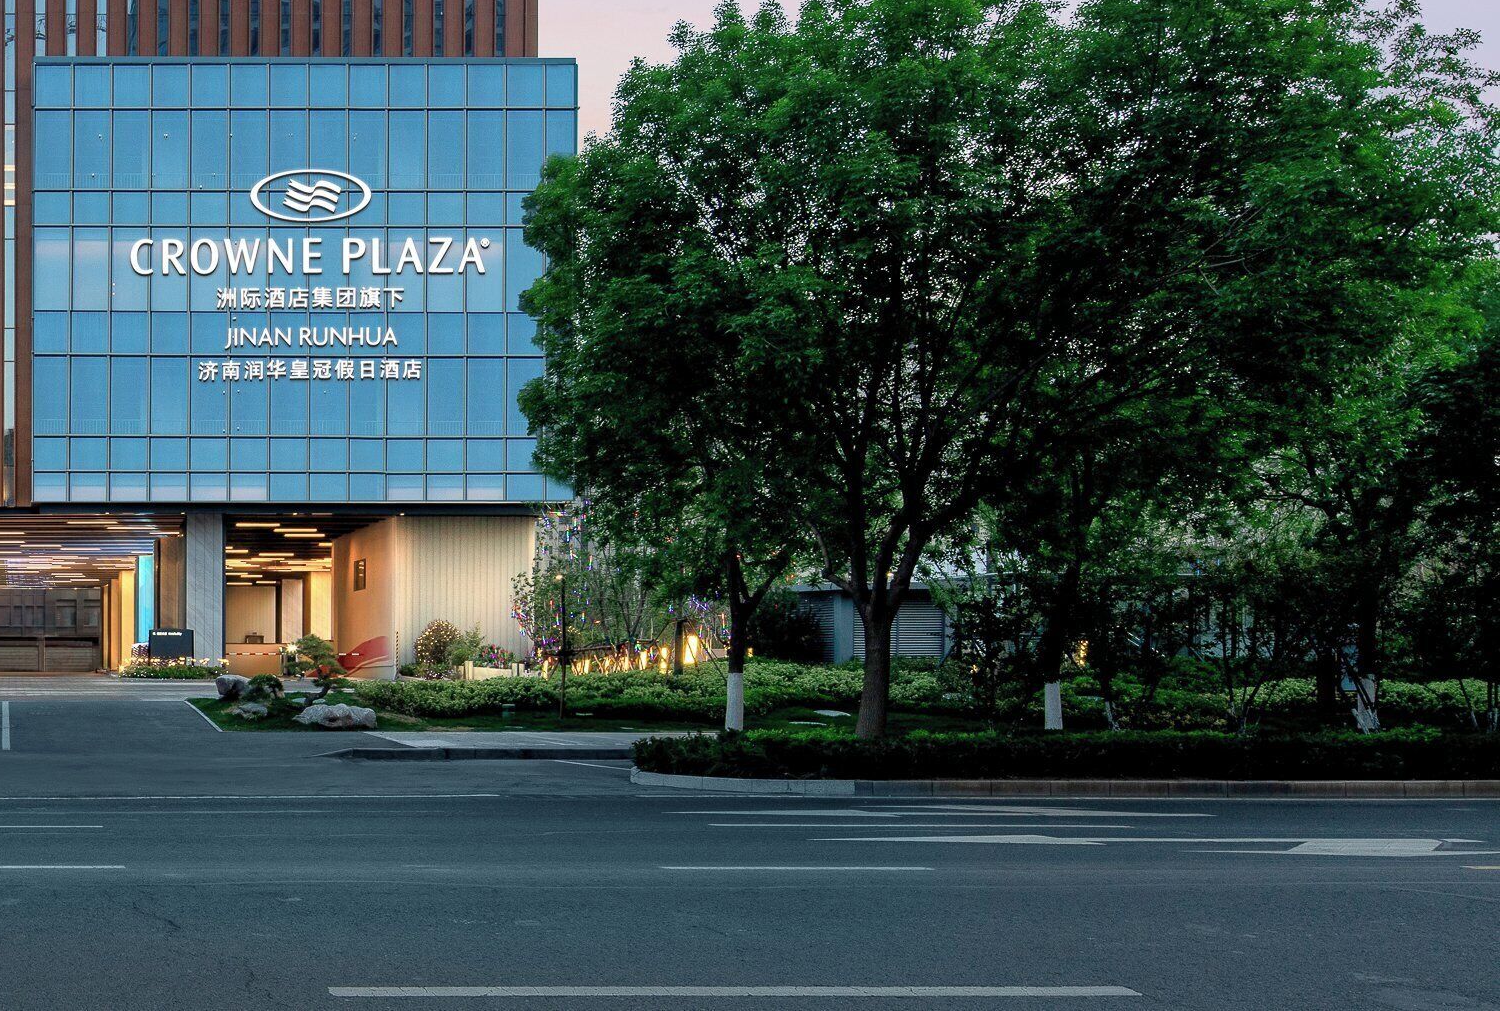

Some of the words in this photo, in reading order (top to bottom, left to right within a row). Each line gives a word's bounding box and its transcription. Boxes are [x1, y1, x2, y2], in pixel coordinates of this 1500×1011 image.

[130, 237, 323, 276] CROWNE
[216, 287, 405, 309] 洲际酒店集团旗下
[225, 327, 292, 349] JINAN
[299, 327, 398, 346] RUNHUA
[198, 359, 422, 380] 济南润华皇冠假日酒店
